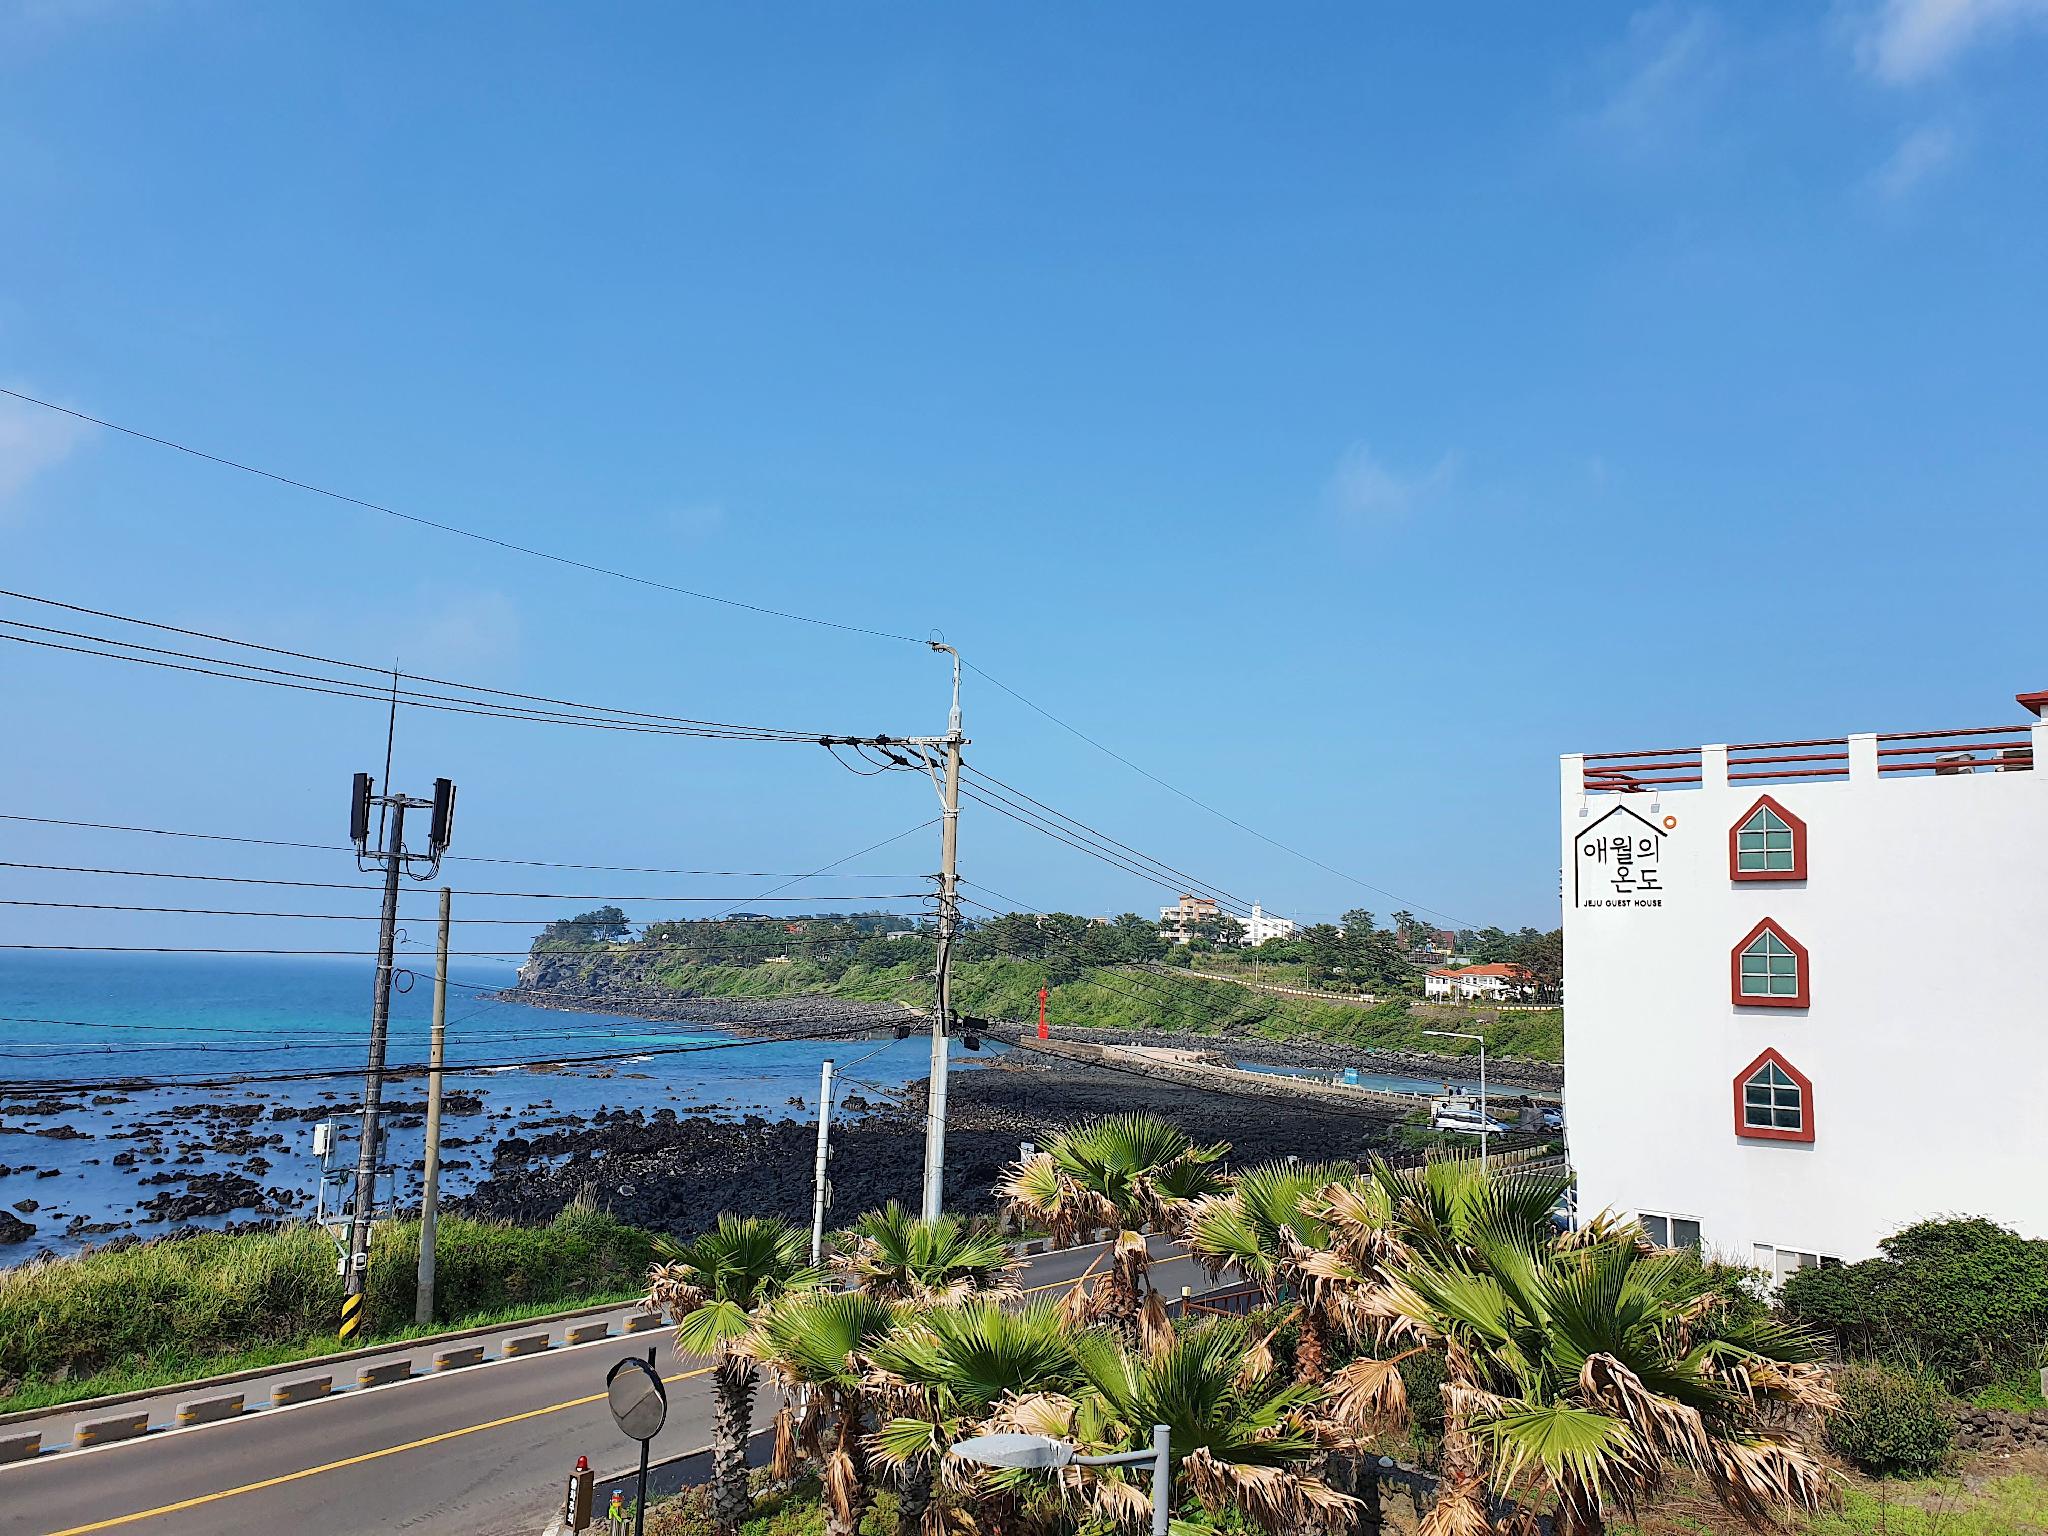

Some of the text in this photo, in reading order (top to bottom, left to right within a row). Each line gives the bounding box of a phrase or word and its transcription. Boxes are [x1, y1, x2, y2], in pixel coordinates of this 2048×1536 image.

[1584, 835, 1659, 865] 애월의
[1610, 866, 1663, 893] 온도
[1583, 899, 1662, 908] JEJU GUEST HOUSE
